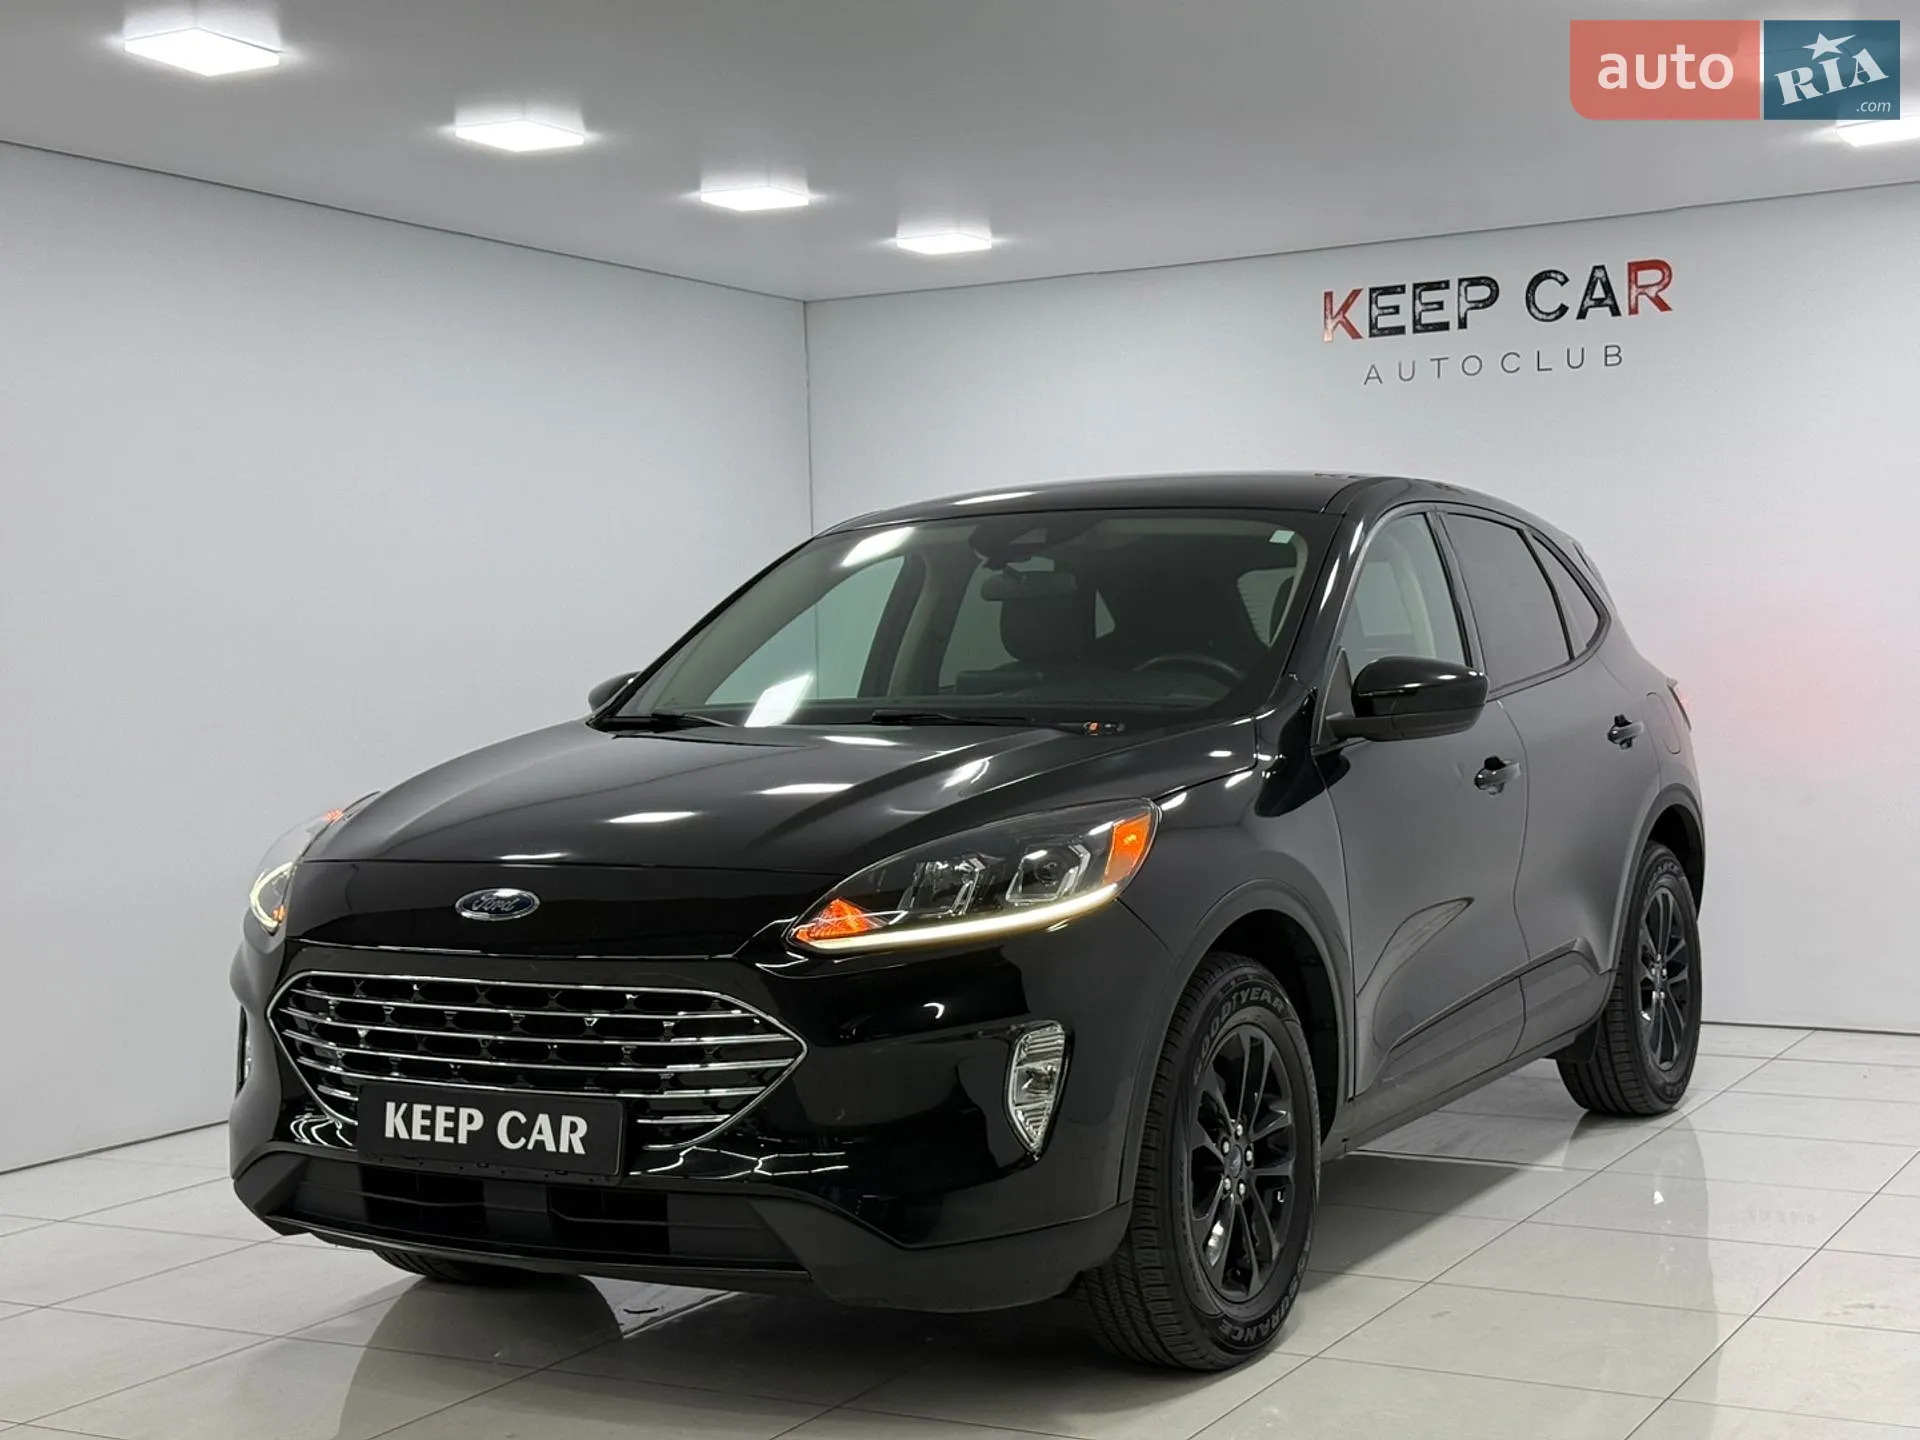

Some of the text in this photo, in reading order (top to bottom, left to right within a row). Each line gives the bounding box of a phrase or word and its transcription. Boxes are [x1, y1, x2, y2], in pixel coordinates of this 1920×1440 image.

[1322, 259, 1674, 342] KEEP CAR
[1363, 344, 1624, 386] AUTOCLUB
[471, 892, 521, 911] Ford
[385, 1101, 588, 1155] KEEP CAR
